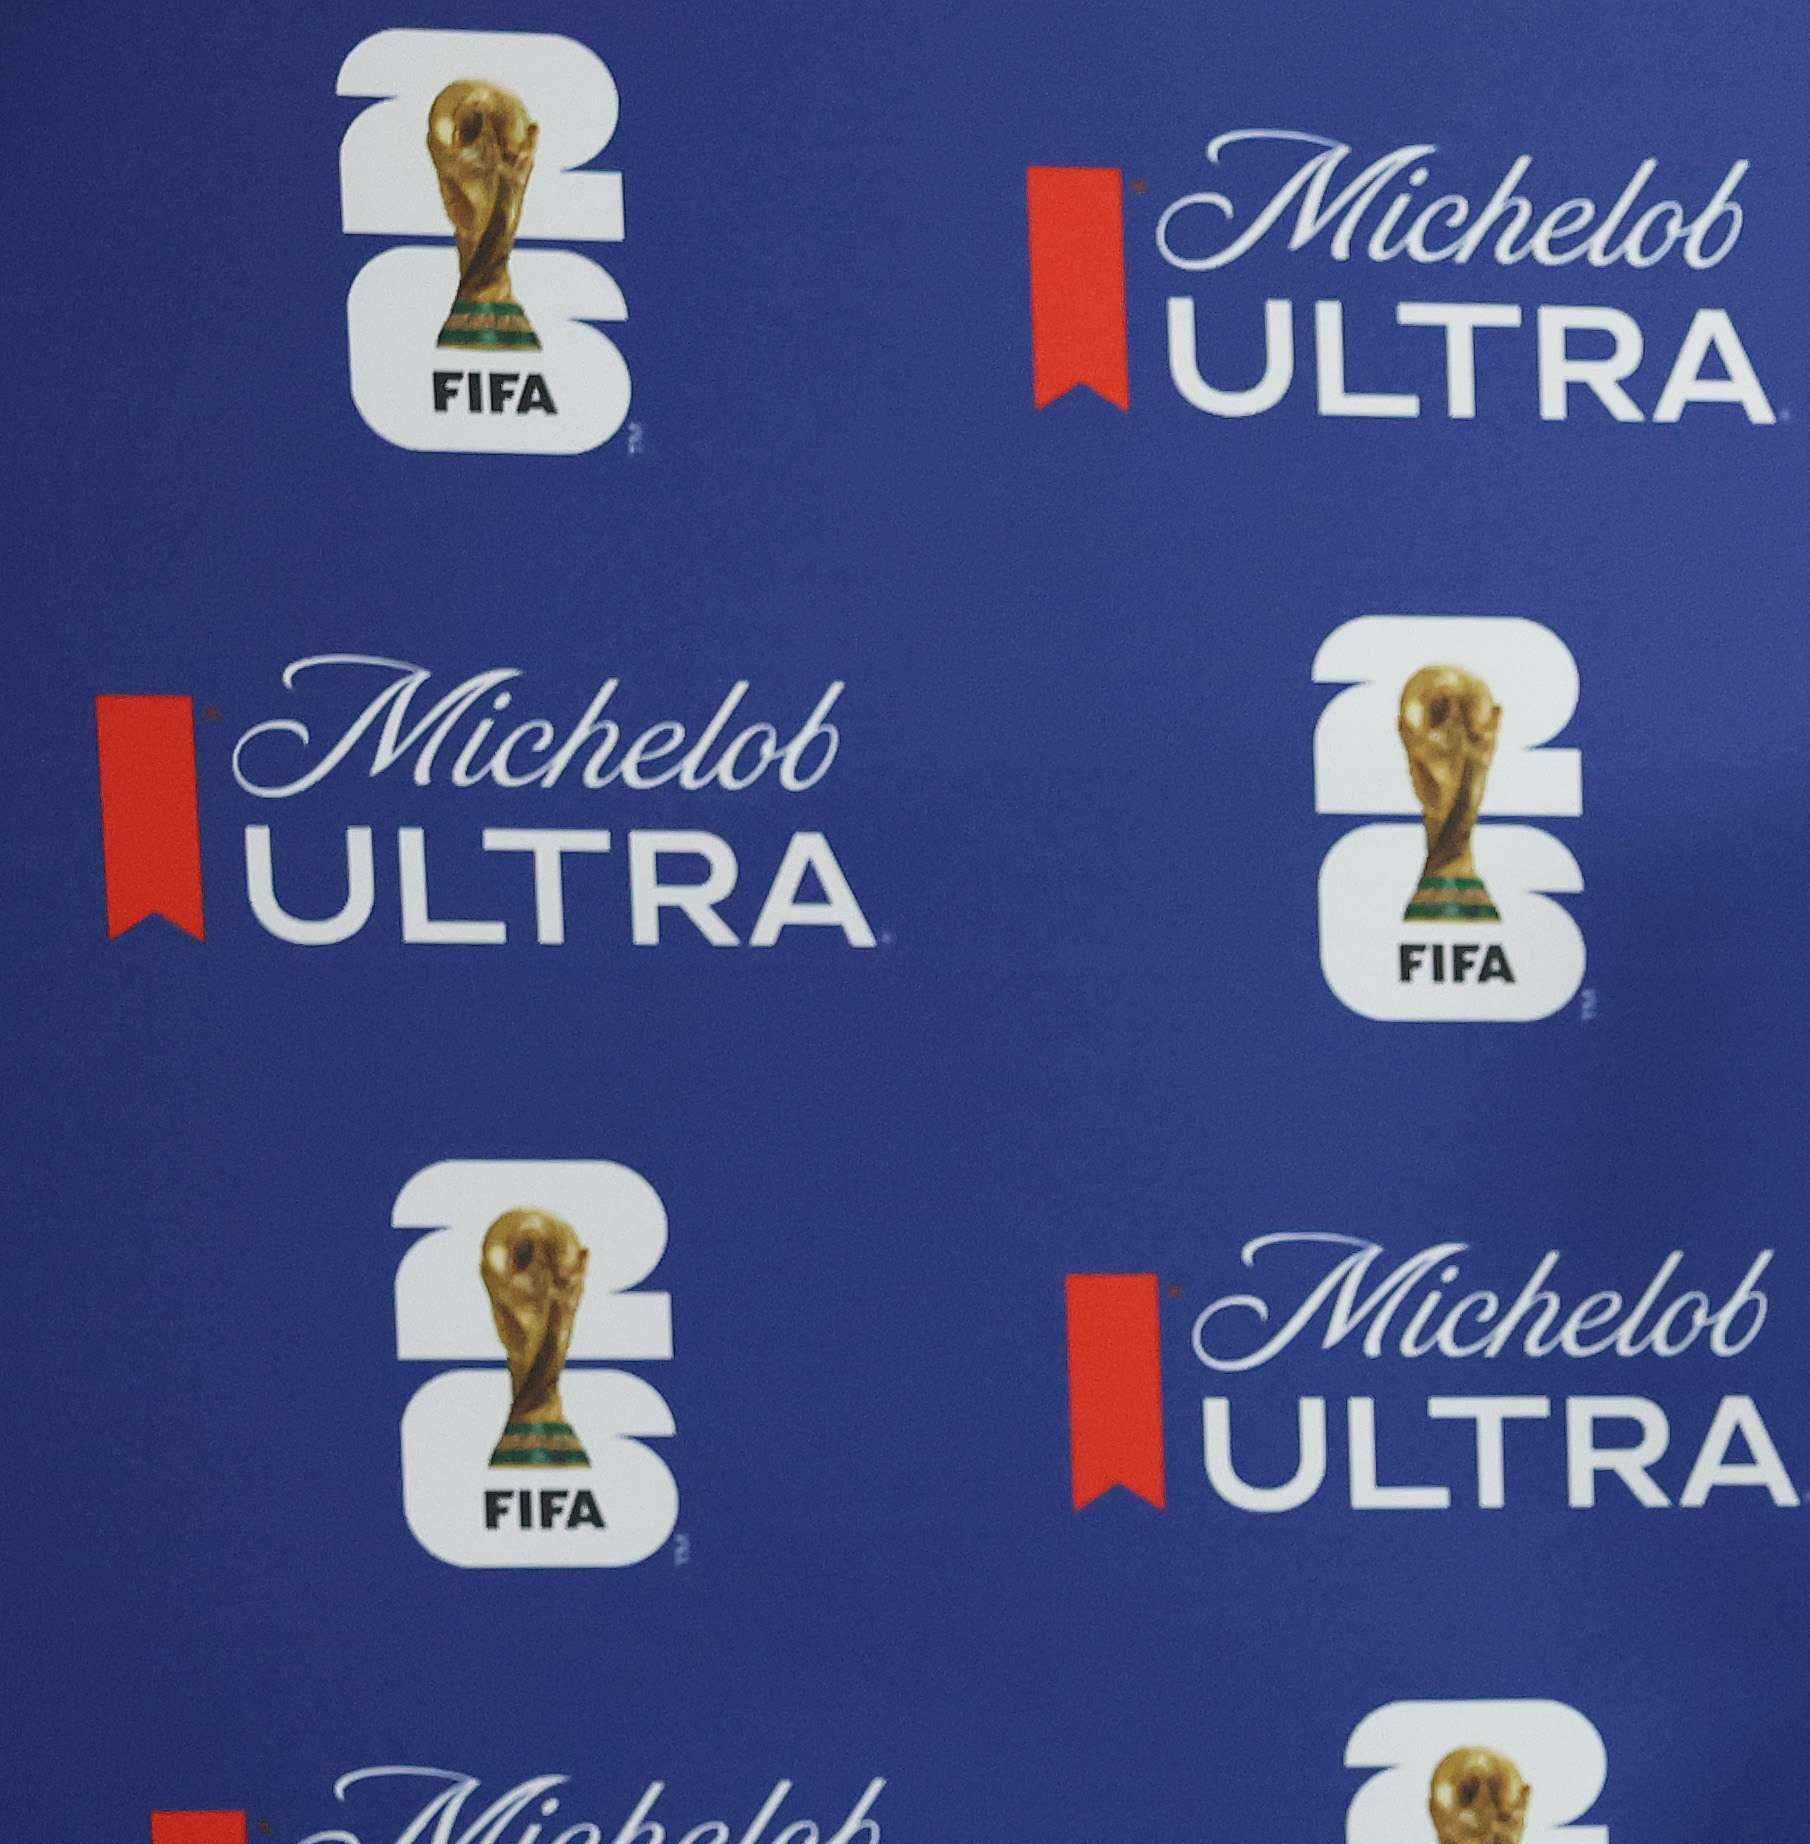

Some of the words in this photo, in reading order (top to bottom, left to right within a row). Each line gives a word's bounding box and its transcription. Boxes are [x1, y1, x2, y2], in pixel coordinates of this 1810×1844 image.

[1154, 128, 1750, 272] Michelob
[431, 369, 559, 416] FIFA
[1166, 295, 1778, 426] ULTRA
[230, 652, 846, 799] Michelob
[243, 823, 878, 949] ULTRA
[1398, 942, 1517, 984] FIFA
[1190, 1231, 1775, 1373] Michelob
[483, 1488, 606, 1531] FIFA
[1201, 1394, 1801, 1514] ULTRA
